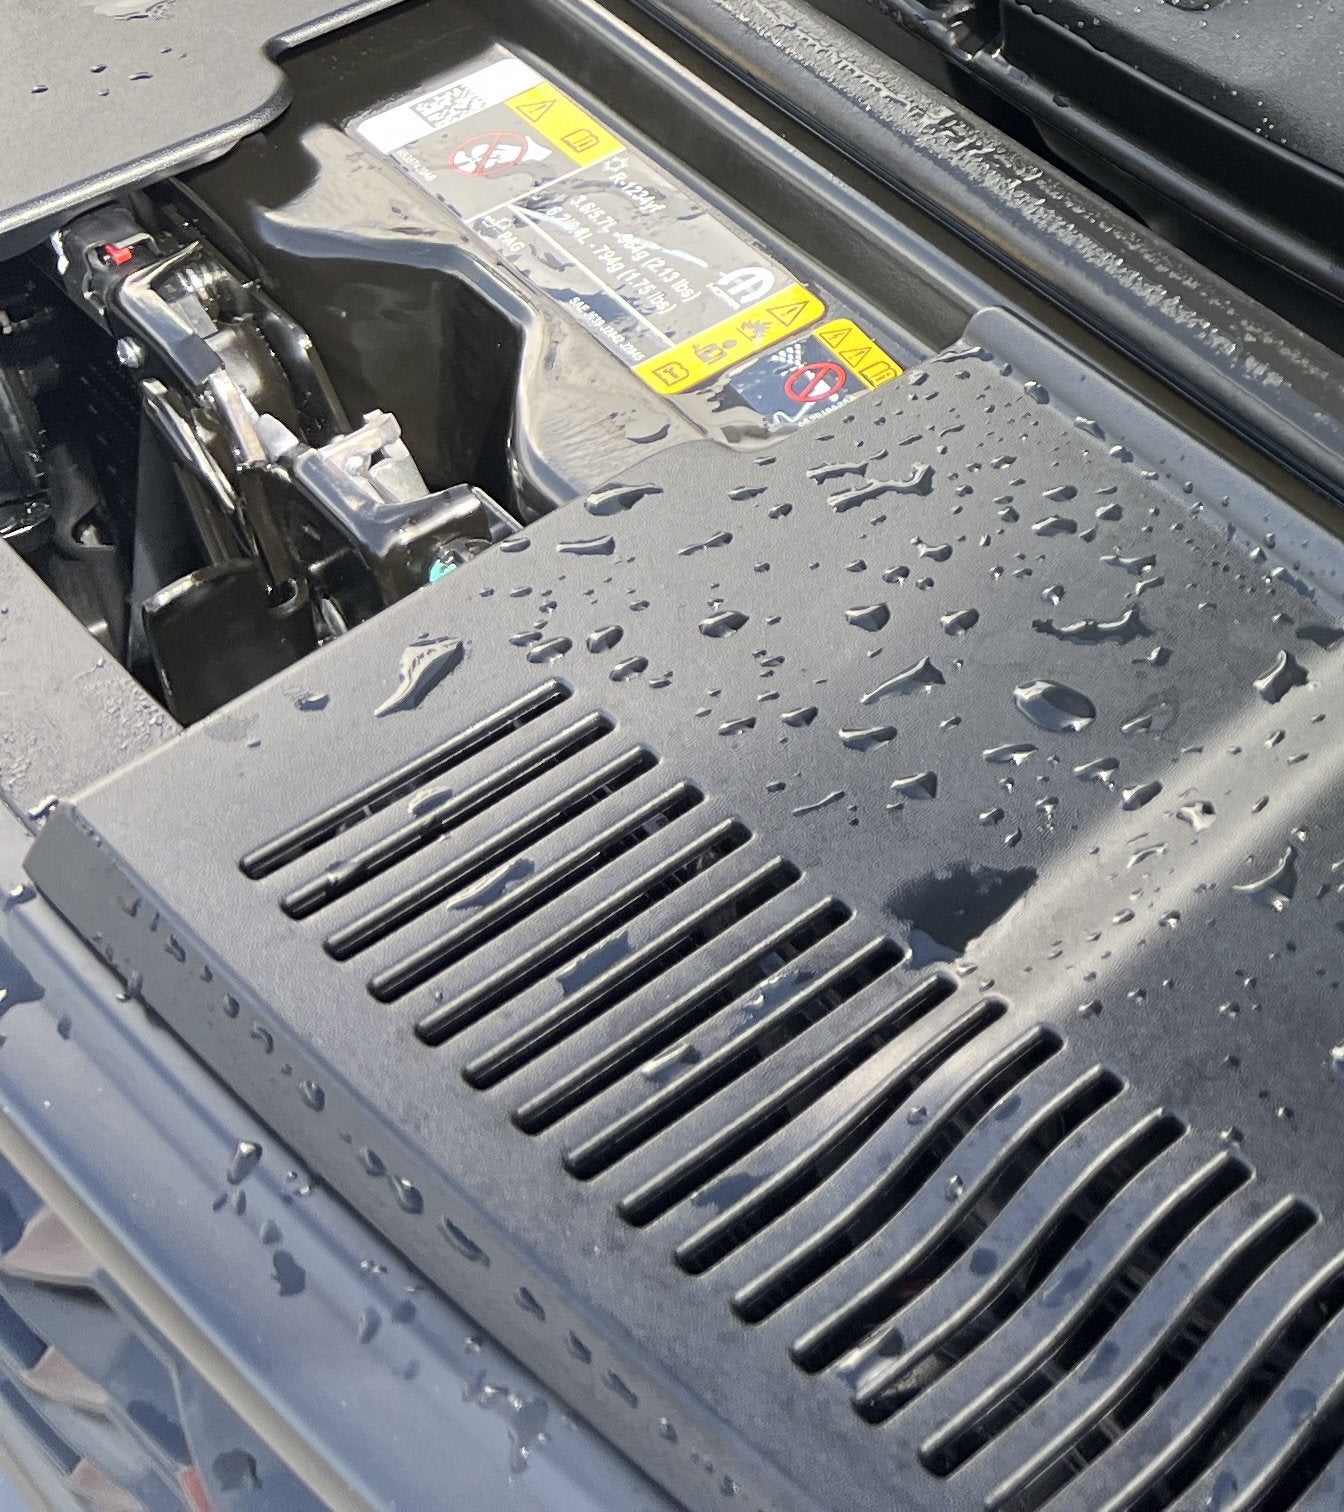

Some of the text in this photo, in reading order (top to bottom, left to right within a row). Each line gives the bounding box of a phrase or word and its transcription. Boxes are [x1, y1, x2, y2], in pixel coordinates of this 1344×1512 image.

[610, 171, 666, 214] R-1234yf
[499, 231, 525, 251] PAG
[594, 246, 625, 274] 794g
[618, 270, 656, 295] (1.75
[648, 291, 677, 314] lbs)
[643, 258, 680, 283] (2.13
[672, 279, 701, 301] lbs)
[570, 297, 590, 312] SAE
